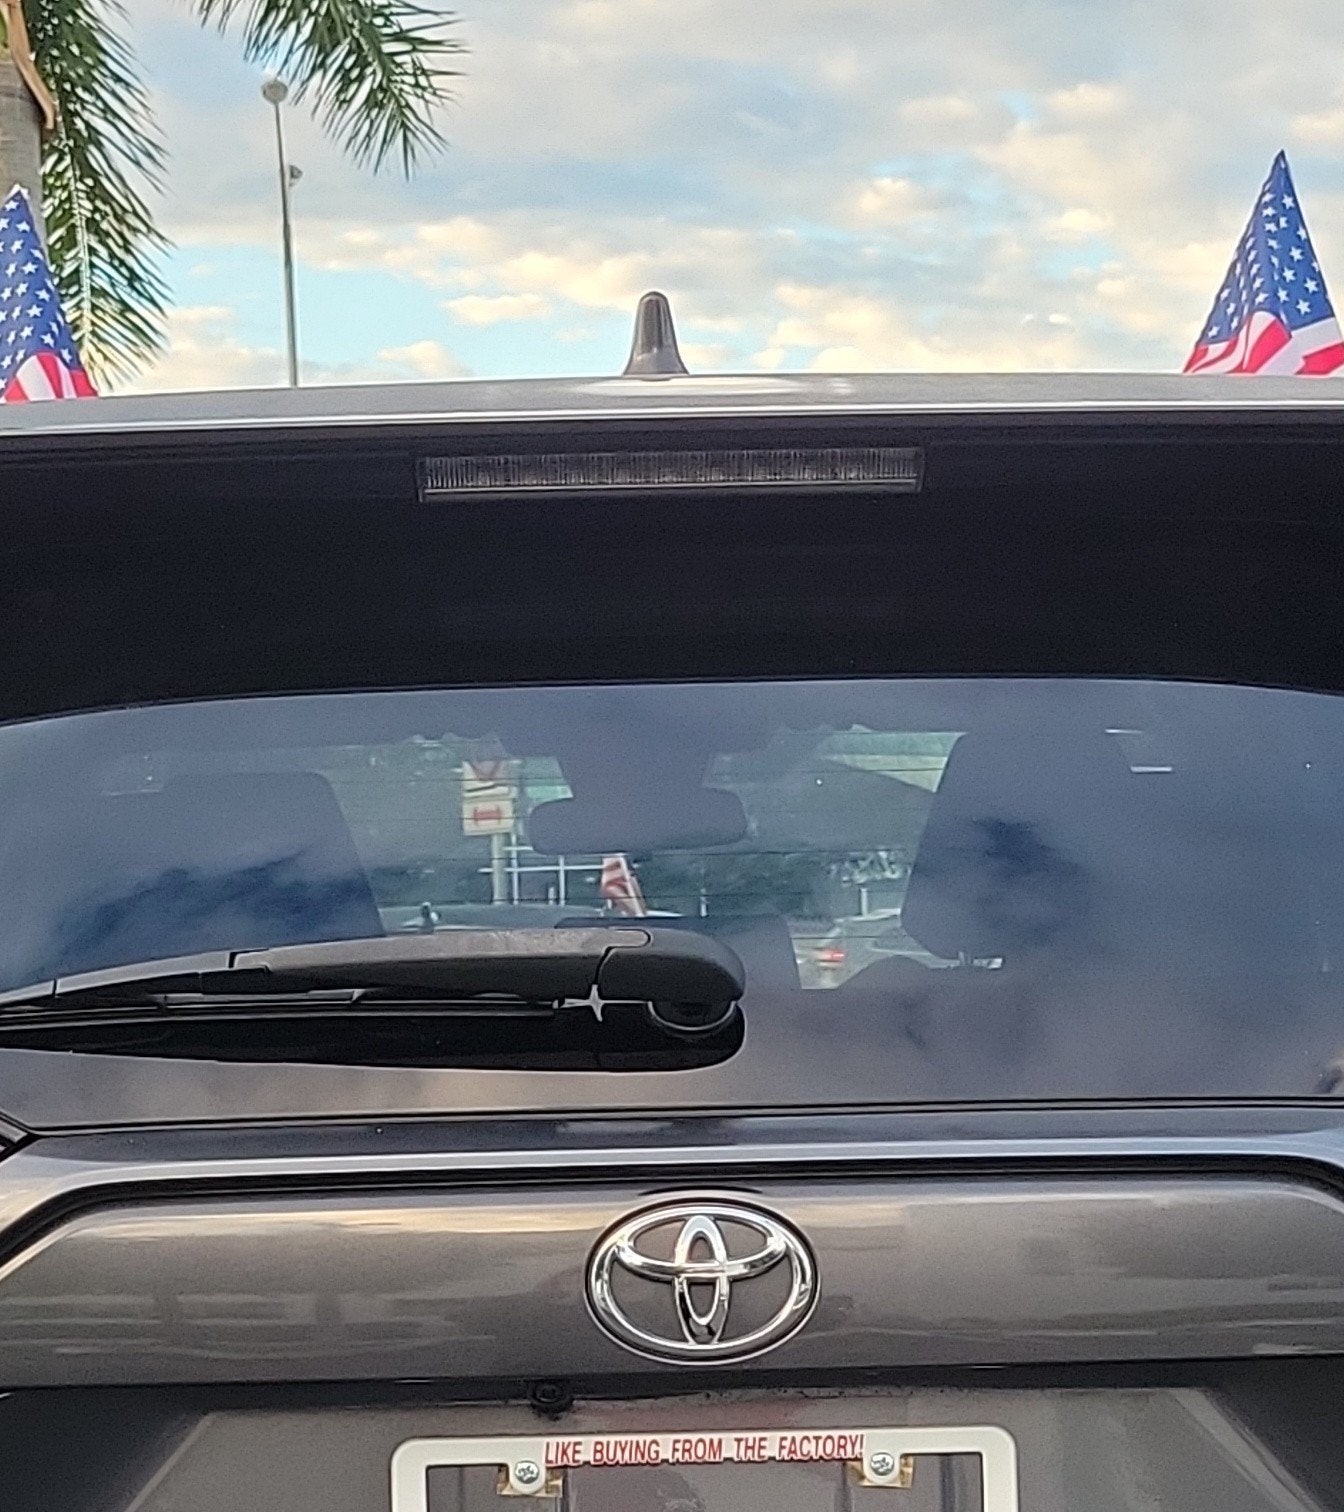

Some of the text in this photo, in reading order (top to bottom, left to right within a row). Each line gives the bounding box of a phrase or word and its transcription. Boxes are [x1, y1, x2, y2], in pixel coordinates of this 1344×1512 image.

[544, 1434, 865, 1465] LIKE BUYING FROM THE FACTORY!
